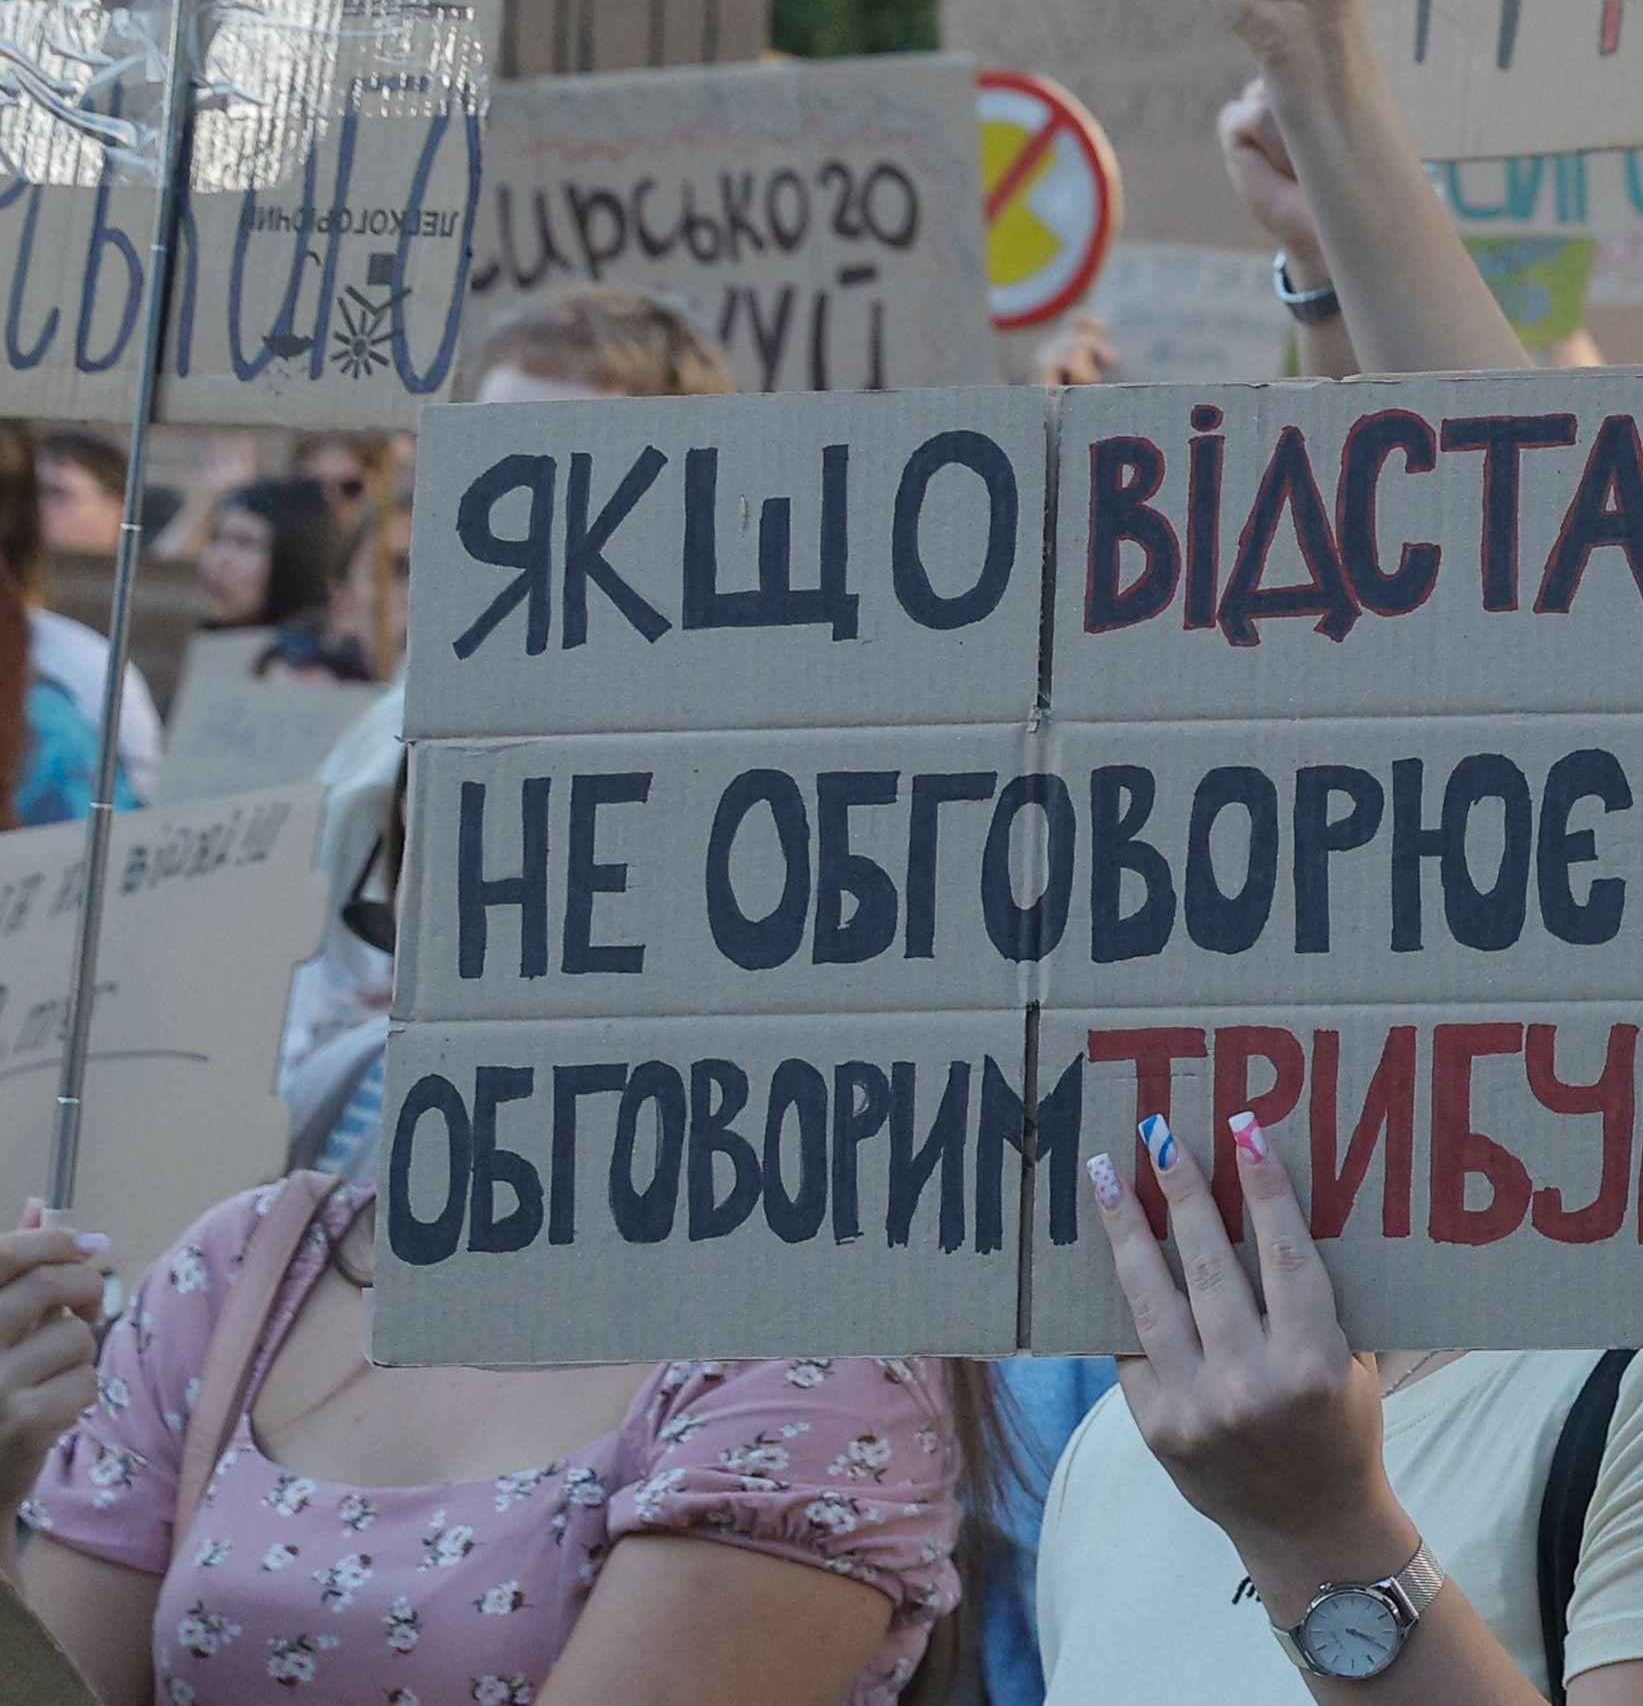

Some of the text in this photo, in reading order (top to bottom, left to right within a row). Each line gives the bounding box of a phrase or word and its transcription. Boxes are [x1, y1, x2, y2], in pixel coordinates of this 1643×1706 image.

[452, 430, 1019, 661] ЯКЩО
[456, 771, 653, 980] НЕ
[387, 1053, 1085, 1266] ОБГОВОРИМ
